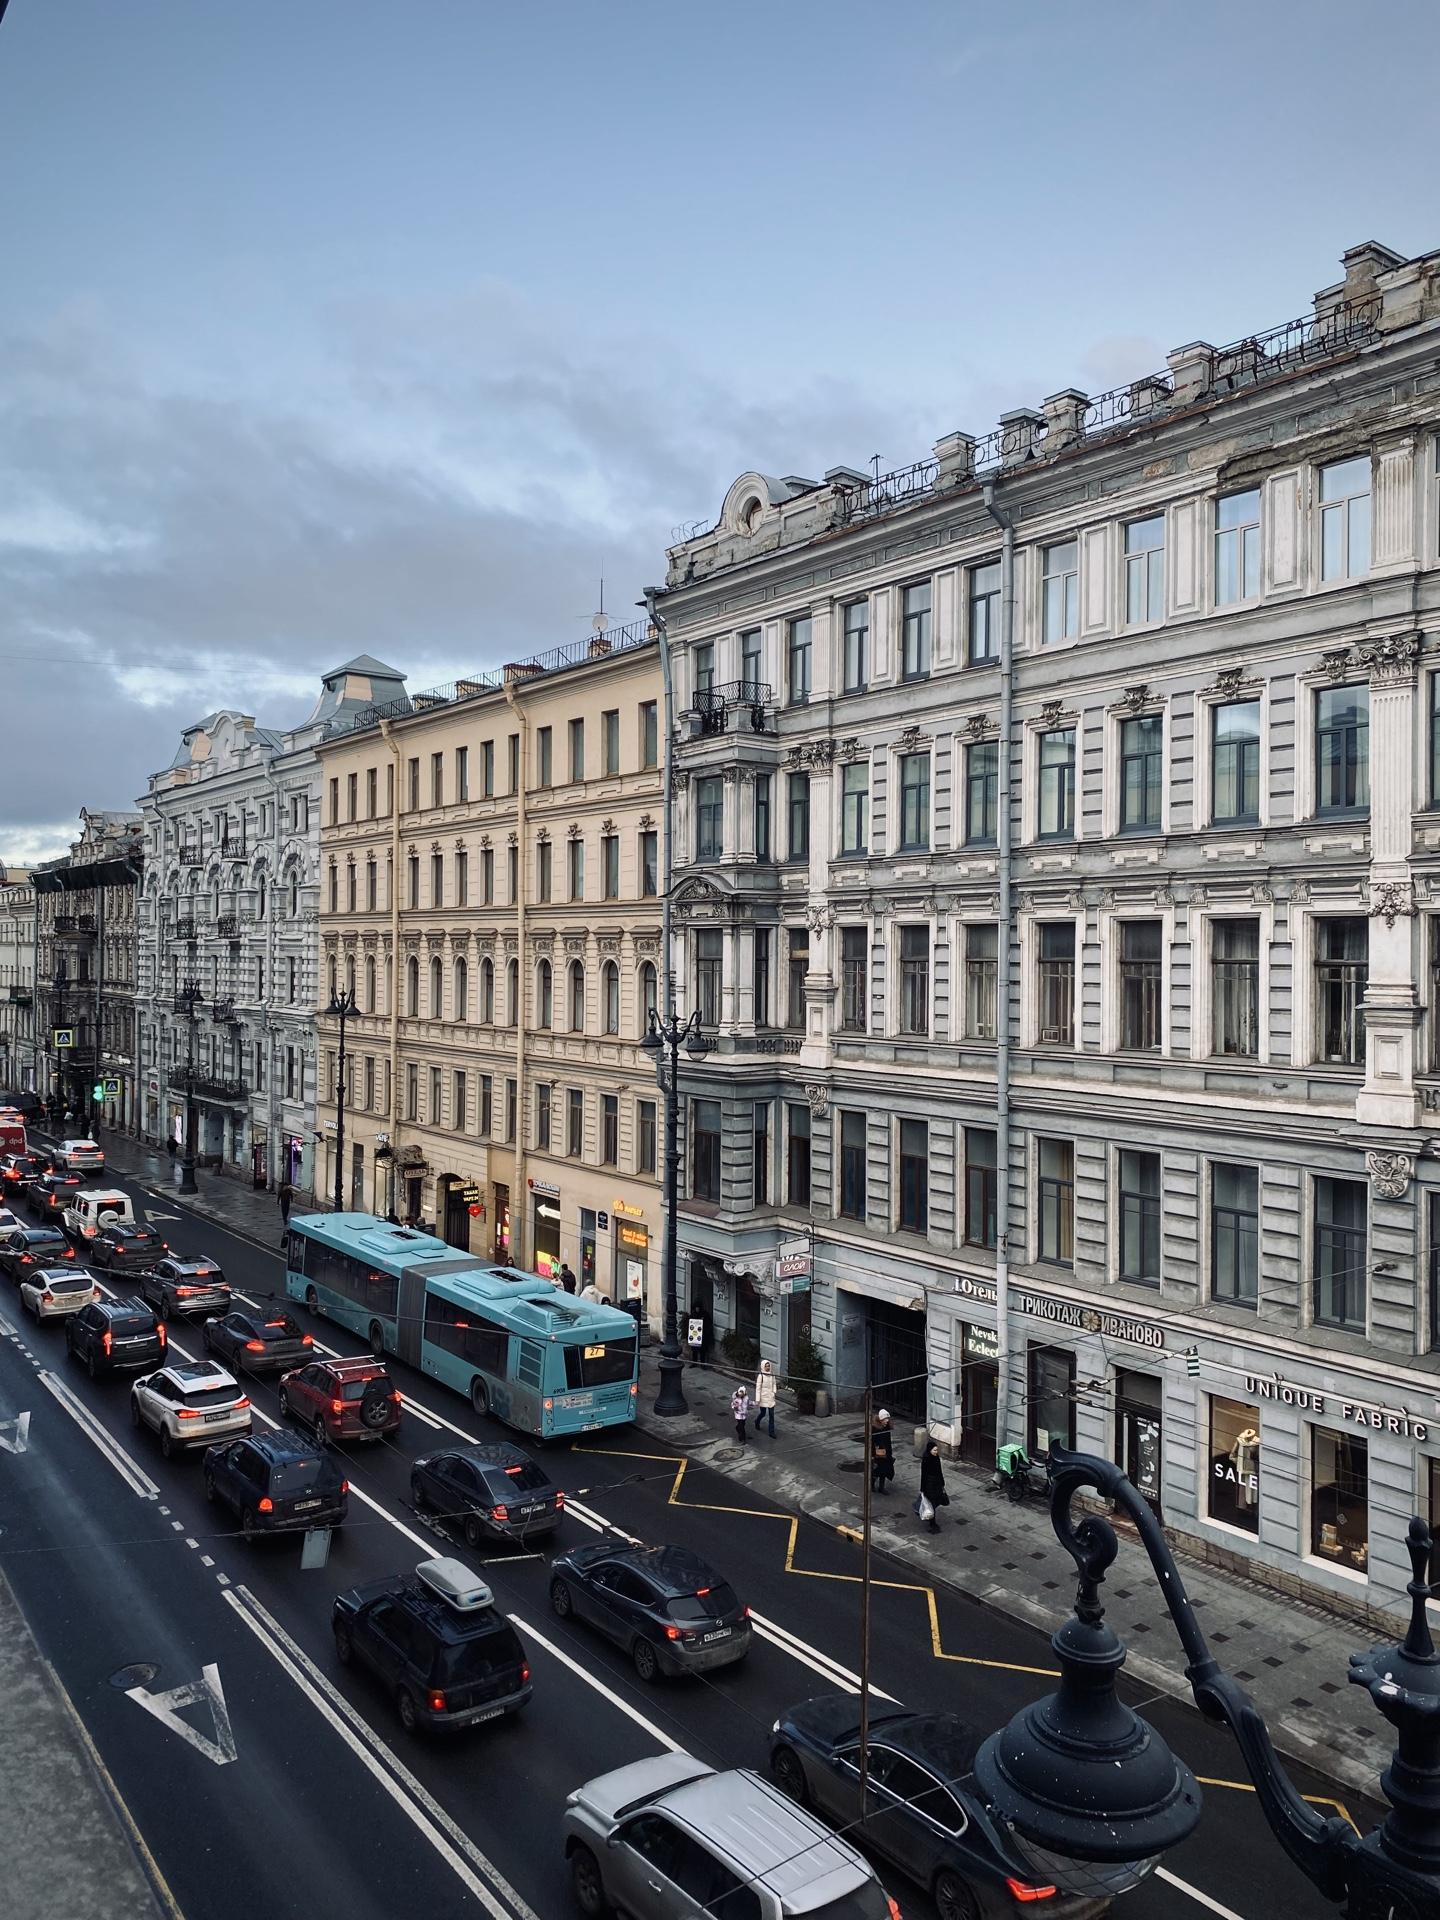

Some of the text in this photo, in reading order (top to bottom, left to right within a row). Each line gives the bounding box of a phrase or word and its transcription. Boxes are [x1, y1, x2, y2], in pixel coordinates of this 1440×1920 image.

[9, 1137, 23, 1145] dpd
[1018, 1294, 1163, 1348] ТРИКОТАЖ ИВАНОВО
[970, 1324, 998, 1342] Nevsk
[590, 1347, 600, 1357] 27
[968, 1338, 999, 1358] Eclect
[1214, 1463, 1259, 1491] SALE
